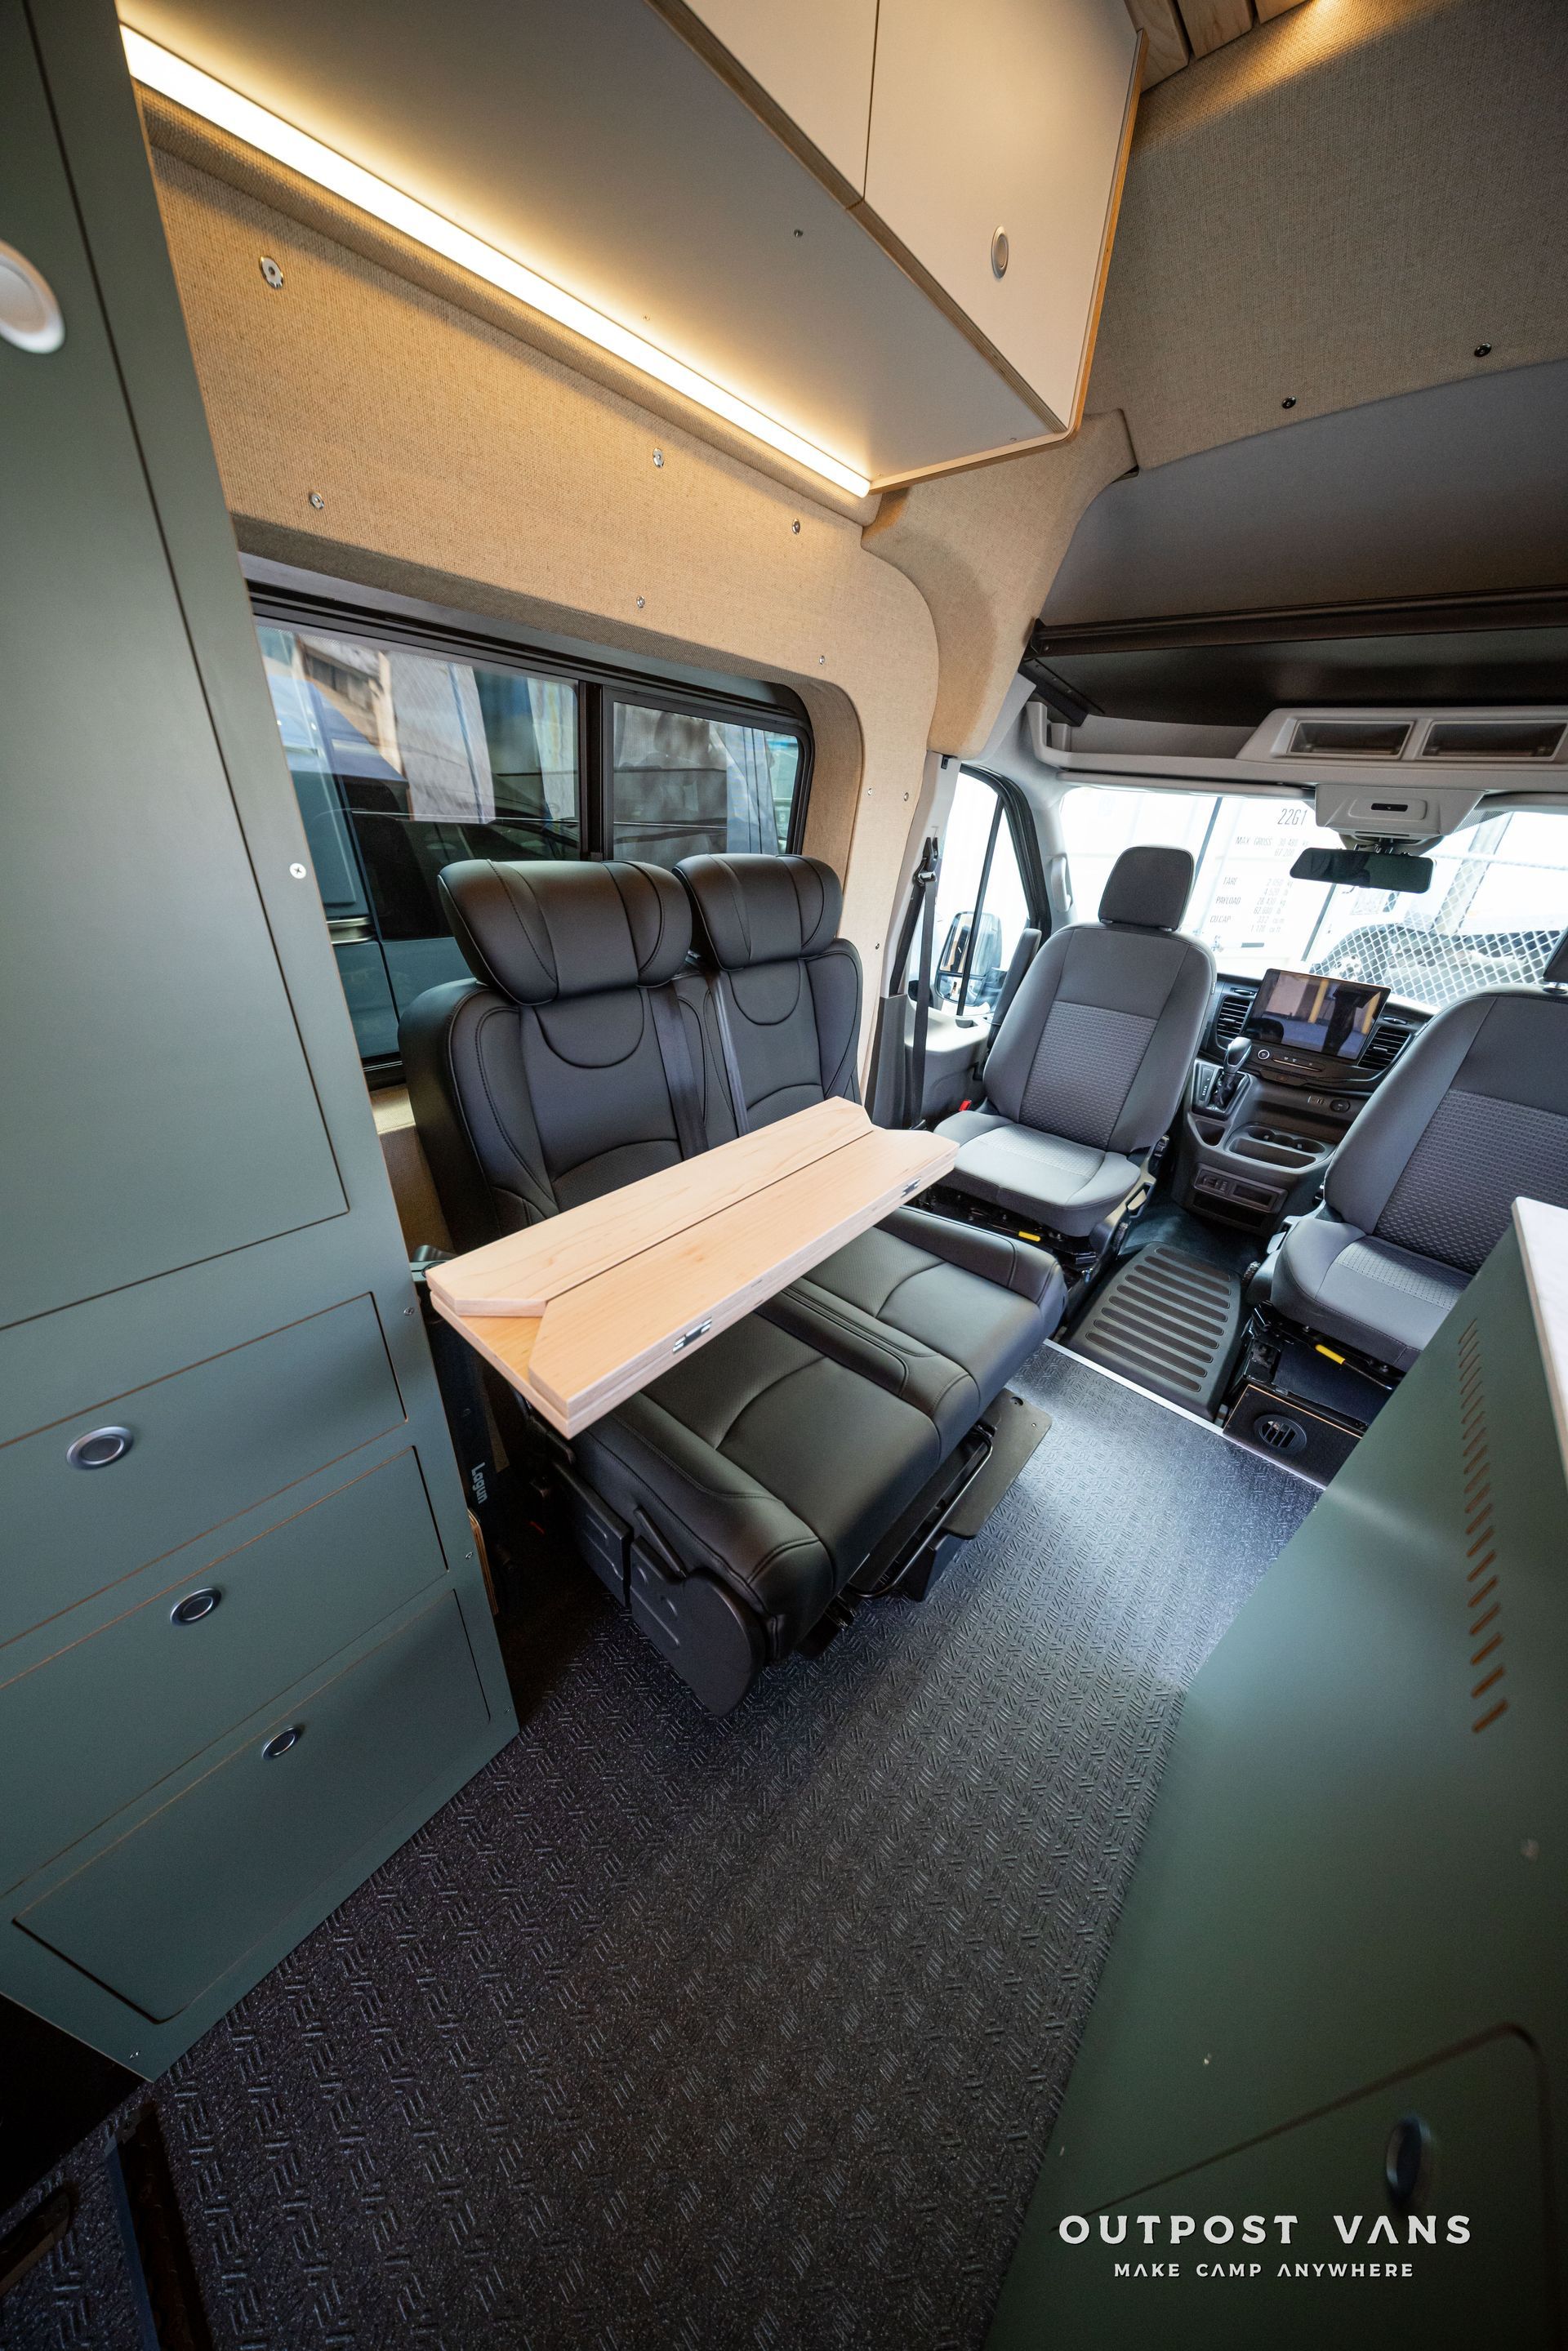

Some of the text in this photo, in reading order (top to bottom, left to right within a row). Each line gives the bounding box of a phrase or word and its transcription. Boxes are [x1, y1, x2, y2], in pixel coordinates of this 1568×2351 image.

[1276, 808, 1308, 826] 22G1
[1254, 836, 1273, 846] GROSS
[1215, 896, 1241, 905] PAYLOAD
[470, 1461, 488, 1505] Lagun
